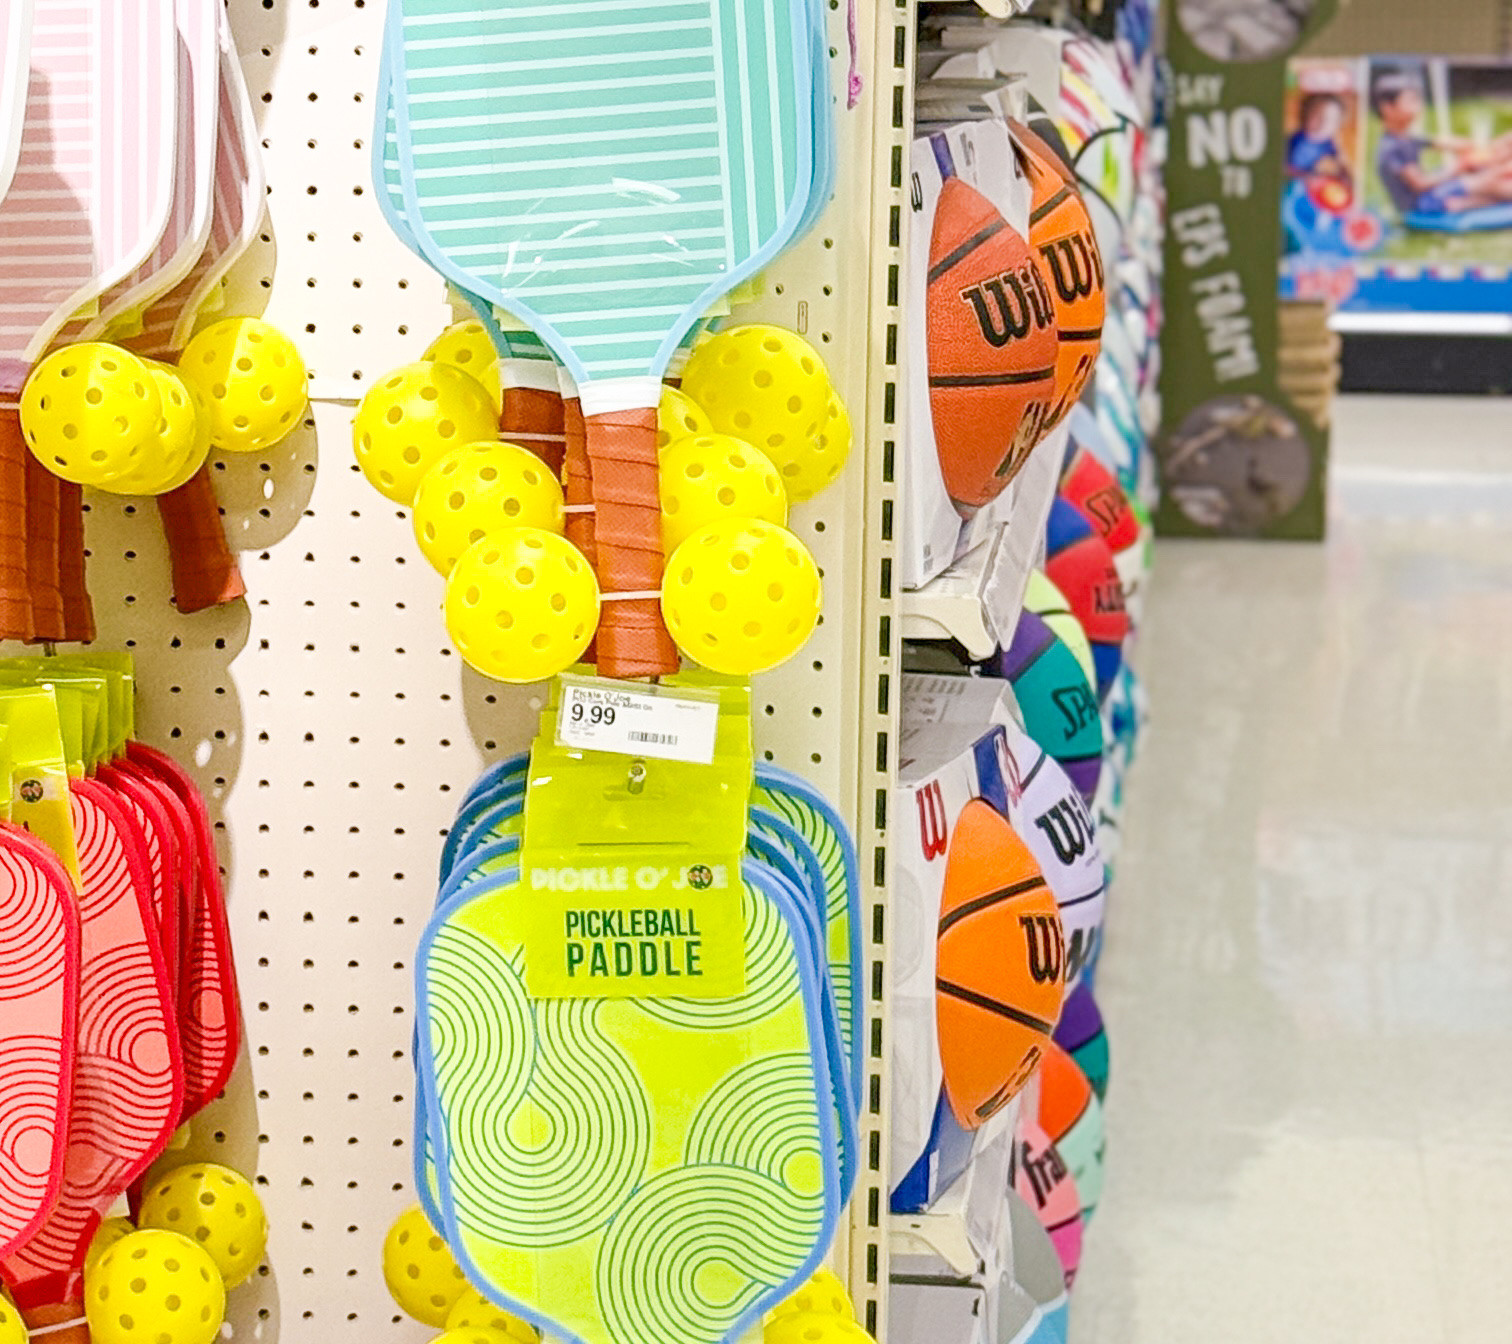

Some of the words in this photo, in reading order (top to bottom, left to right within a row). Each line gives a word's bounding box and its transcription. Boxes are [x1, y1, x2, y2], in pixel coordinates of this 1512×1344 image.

[1187, 105, 1267, 169] NO
[1170, 203, 1230, 268] EPS
[571, 703, 615, 725] 9.99
[916, 779, 948, 862] W
[531, 867, 629, 892] PICKLE
[566, 908, 701, 938] PICKLEBALL
[567, 941, 704, 978] PADDLE
